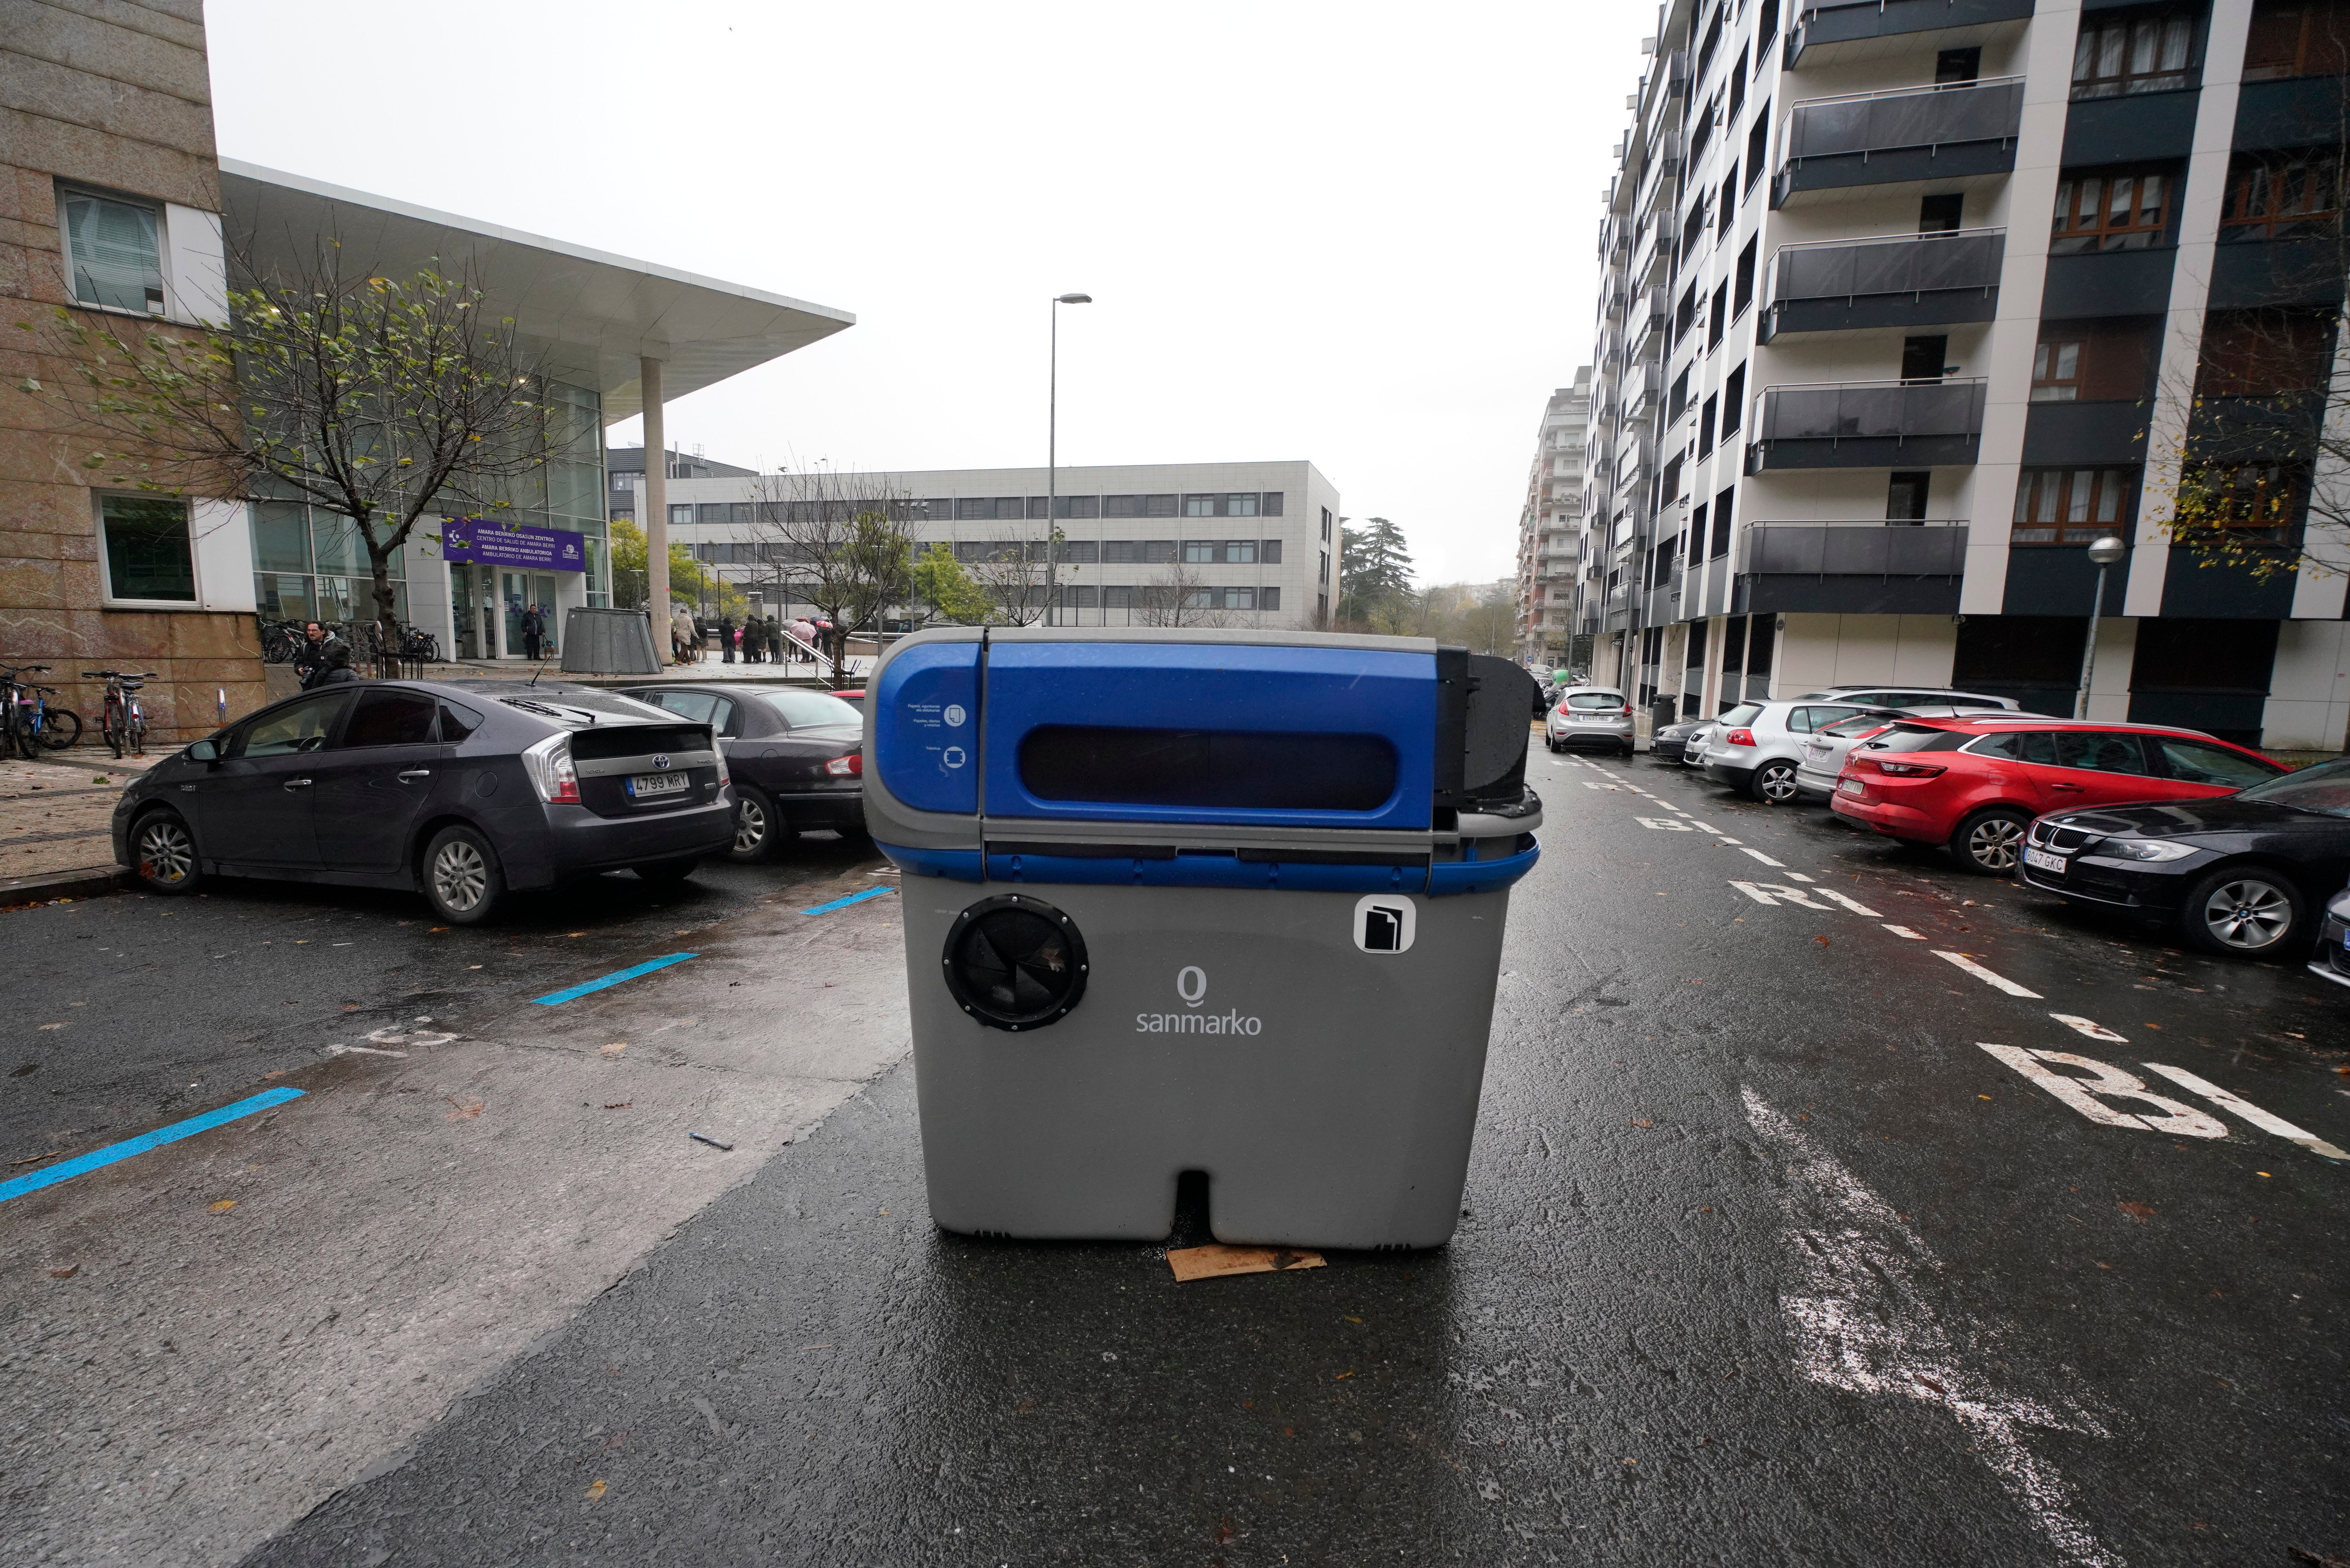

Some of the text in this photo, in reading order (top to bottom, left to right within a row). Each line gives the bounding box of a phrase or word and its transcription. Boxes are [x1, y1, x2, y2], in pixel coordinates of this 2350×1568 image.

[637, 774, 686, 791] 4799 MRY
[1633, 817, 1693, 831] B
[2027, 851, 2063, 870] 8047 GKC
[1727, 880, 1837, 910] R
[1136, 1008, 1262, 1035] sanmarko
[1975, 1042, 2229, 1138] B
